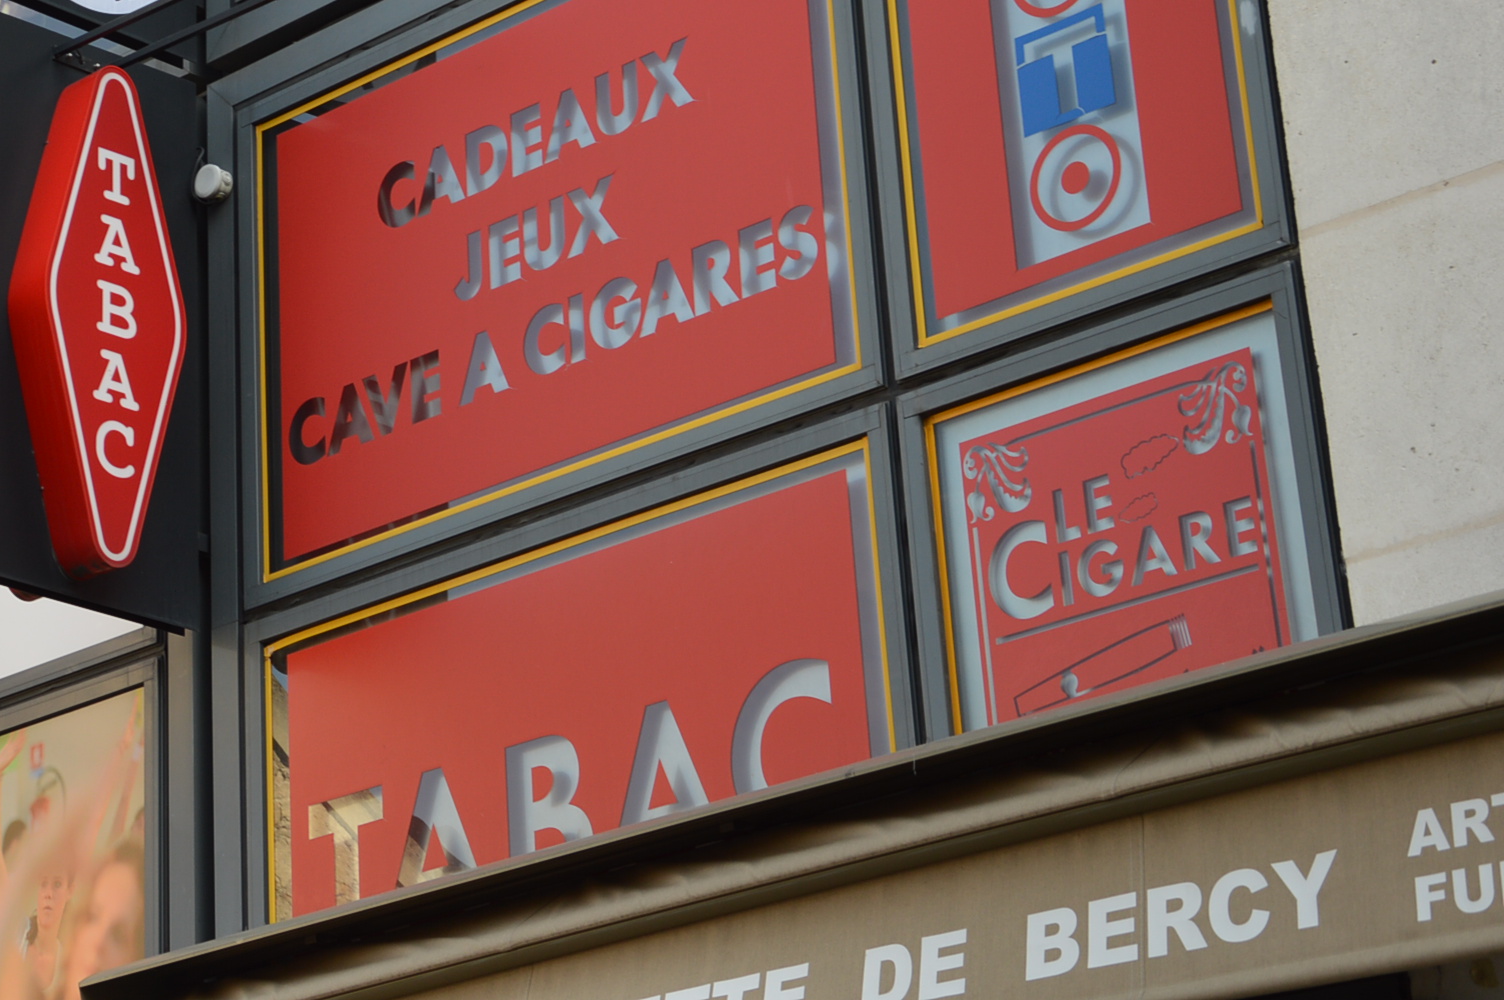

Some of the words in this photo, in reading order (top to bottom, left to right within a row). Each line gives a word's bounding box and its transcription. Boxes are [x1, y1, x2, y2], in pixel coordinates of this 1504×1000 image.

[376, 35, 698, 229] CADEAUX
[453, 172, 622, 301] JEUX
[91, 146, 141, 480] TABAC
[288, 348, 443, 466] CAVE
[457, 329, 514, 409] A
[522, 203, 820, 377] CIGARES
[987, 494, 1259, 620] CIGARE
[1051, 473, 1115, 545] LE
[307, 657, 833, 904] TABAC
[1407, 792, 1504, 858] AR
[860, 927, 968, 1000] DE
[1024, 849, 1338, 982] BERCY
[1413, 861, 1504, 923] FU
